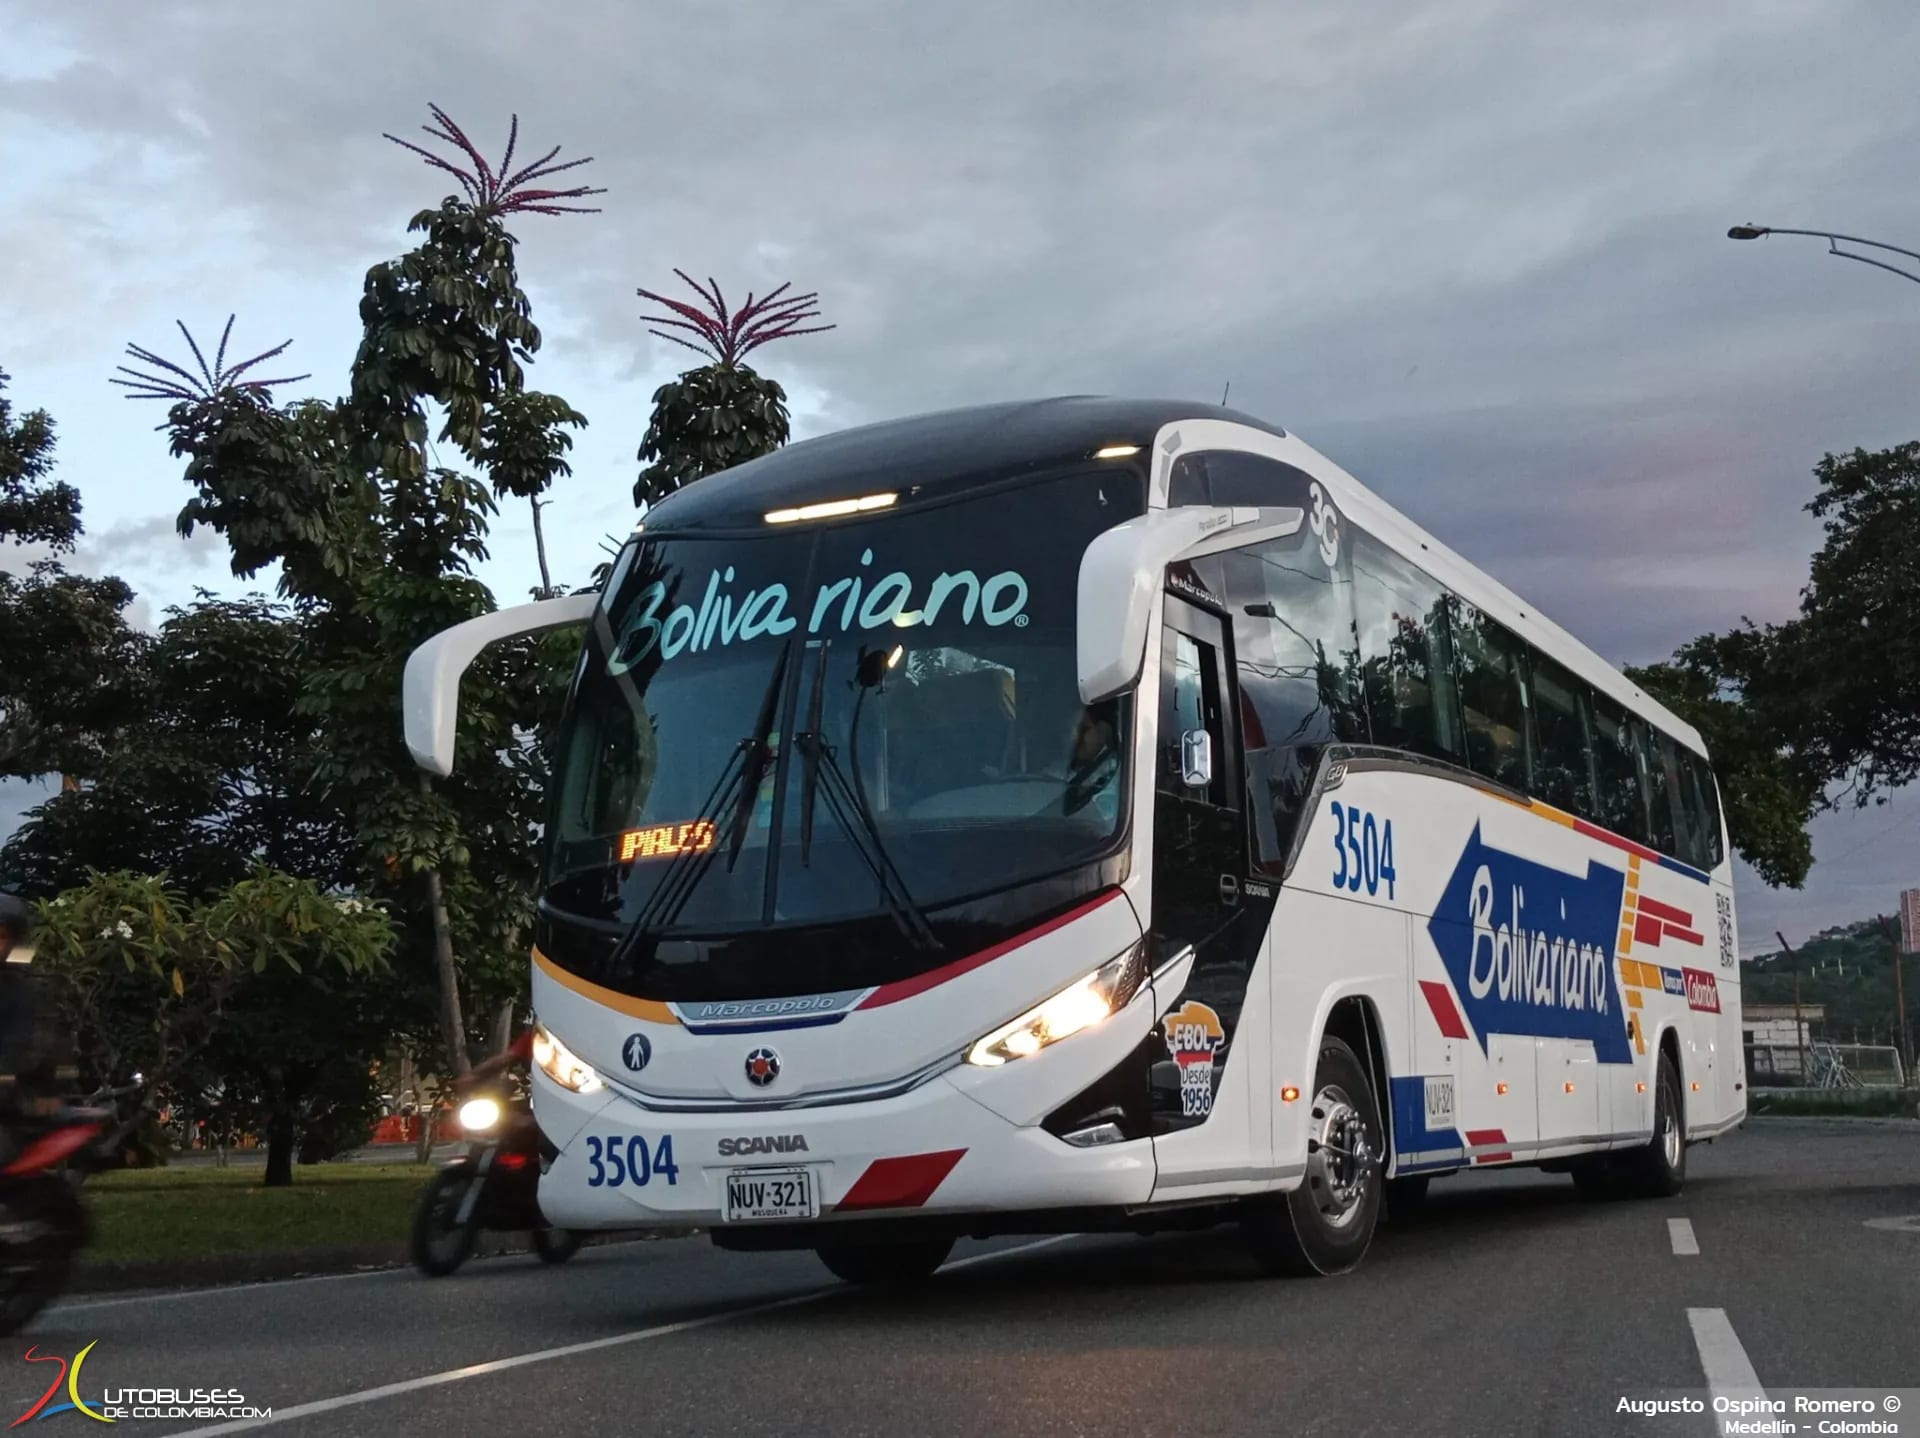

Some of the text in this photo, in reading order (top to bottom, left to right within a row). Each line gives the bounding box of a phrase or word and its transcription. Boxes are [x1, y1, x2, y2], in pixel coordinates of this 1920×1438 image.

[1330, 800, 1396, 901] 3504
[1468, 864, 1608, 1014] Bolivariano
[1687, 974, 1717, 1008] Colombia
[701, 998, 834, 1017] Marcopolo
[1183, 1065, 1210, 1085] Desde
[1182, 1088, 1211, 1113] 1956
[718, 1134, 809, 1157] SCANIA
[586, 1134, 679, 1188] 3504
